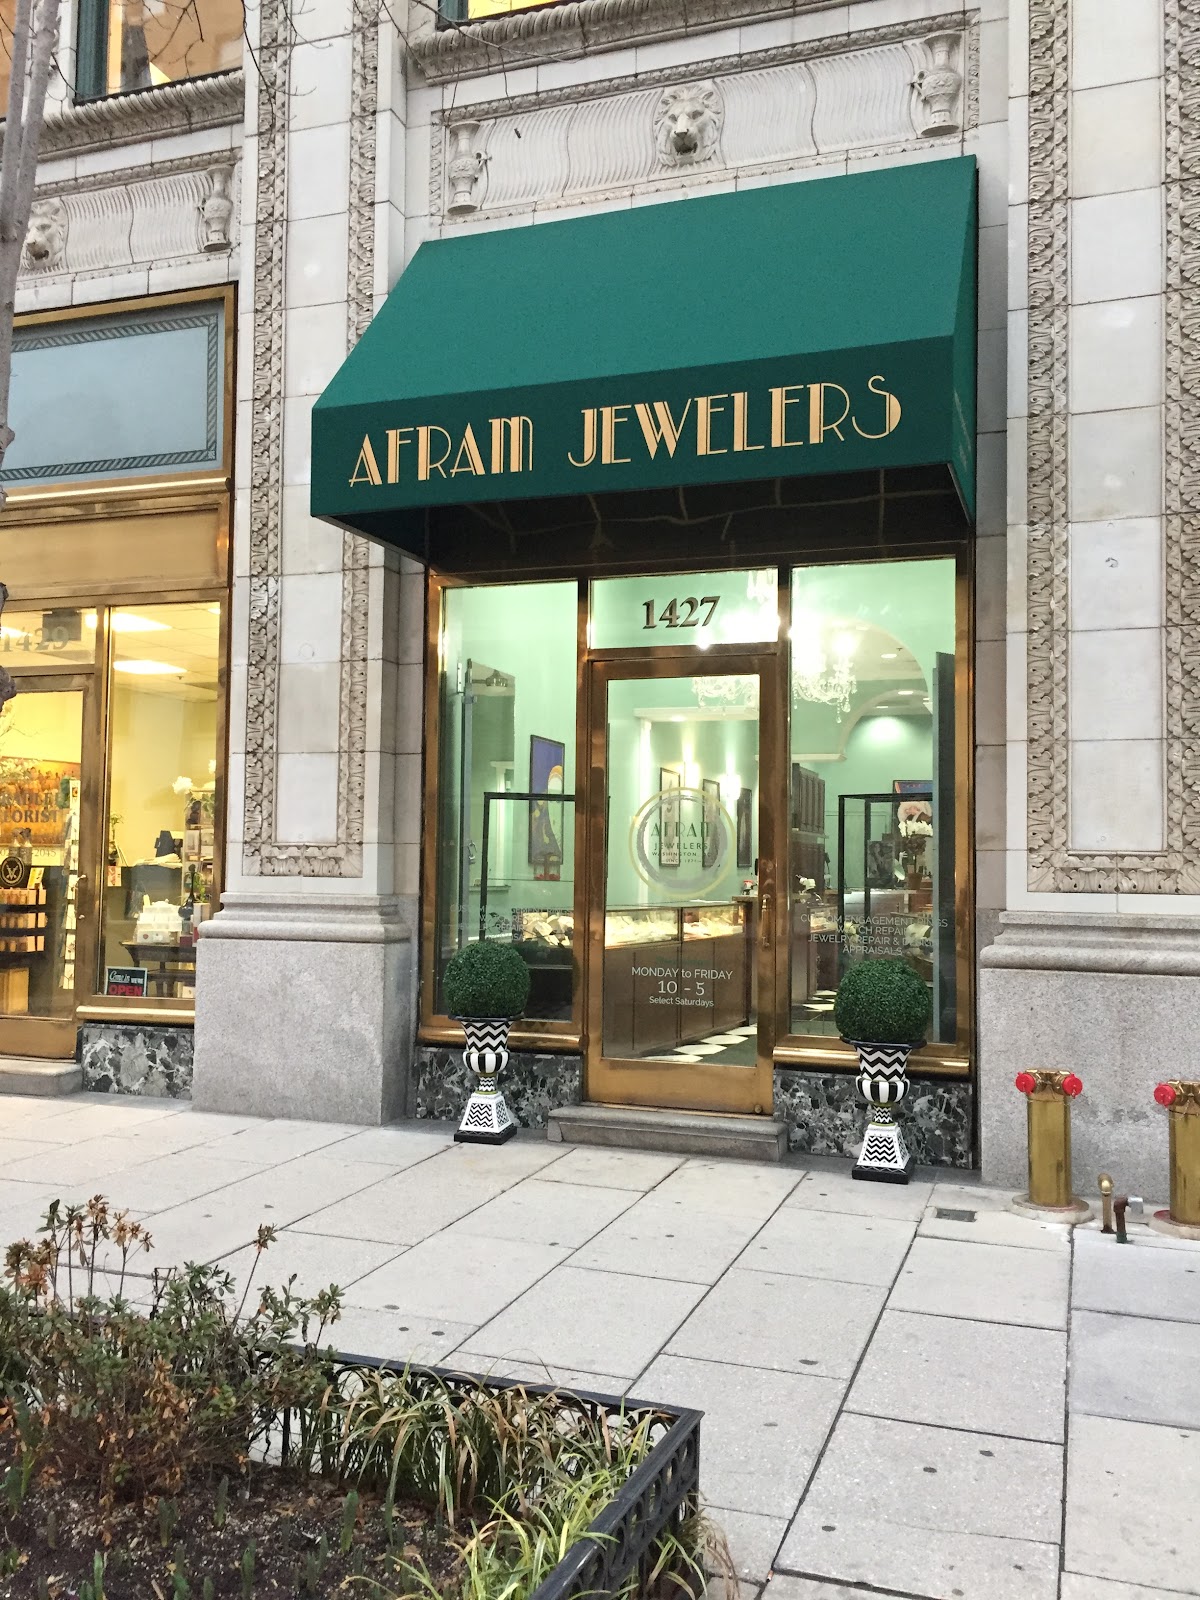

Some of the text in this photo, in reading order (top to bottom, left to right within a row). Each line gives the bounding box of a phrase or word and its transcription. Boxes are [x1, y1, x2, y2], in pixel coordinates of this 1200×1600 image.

[348, 416, 535, 488] AFRAM
[567, 375, 903, 468] JEWELERS
[643, 596, 720, 629] 1427
[3, 625, 69, 652] 1429
[654, 842, 708, 850] JEWELERS
[844, 915, 914, 927] ENGAGEMENT
[808, 933, 852, 943] JEWELRY
[855, 935, 891, 946] REPAIR
[892, 937, 900, 946] &
[842, 945, 903, 956] APPRAISALS
[631, 966, 734, 980] MONDAY to FRIDAY
[109, 984, 143, 996] OPEN
[658, 980, 678, 994] 10
[695, 981, 705, 996] 5
[649, 995, 714, 1008] Select Saturdays
